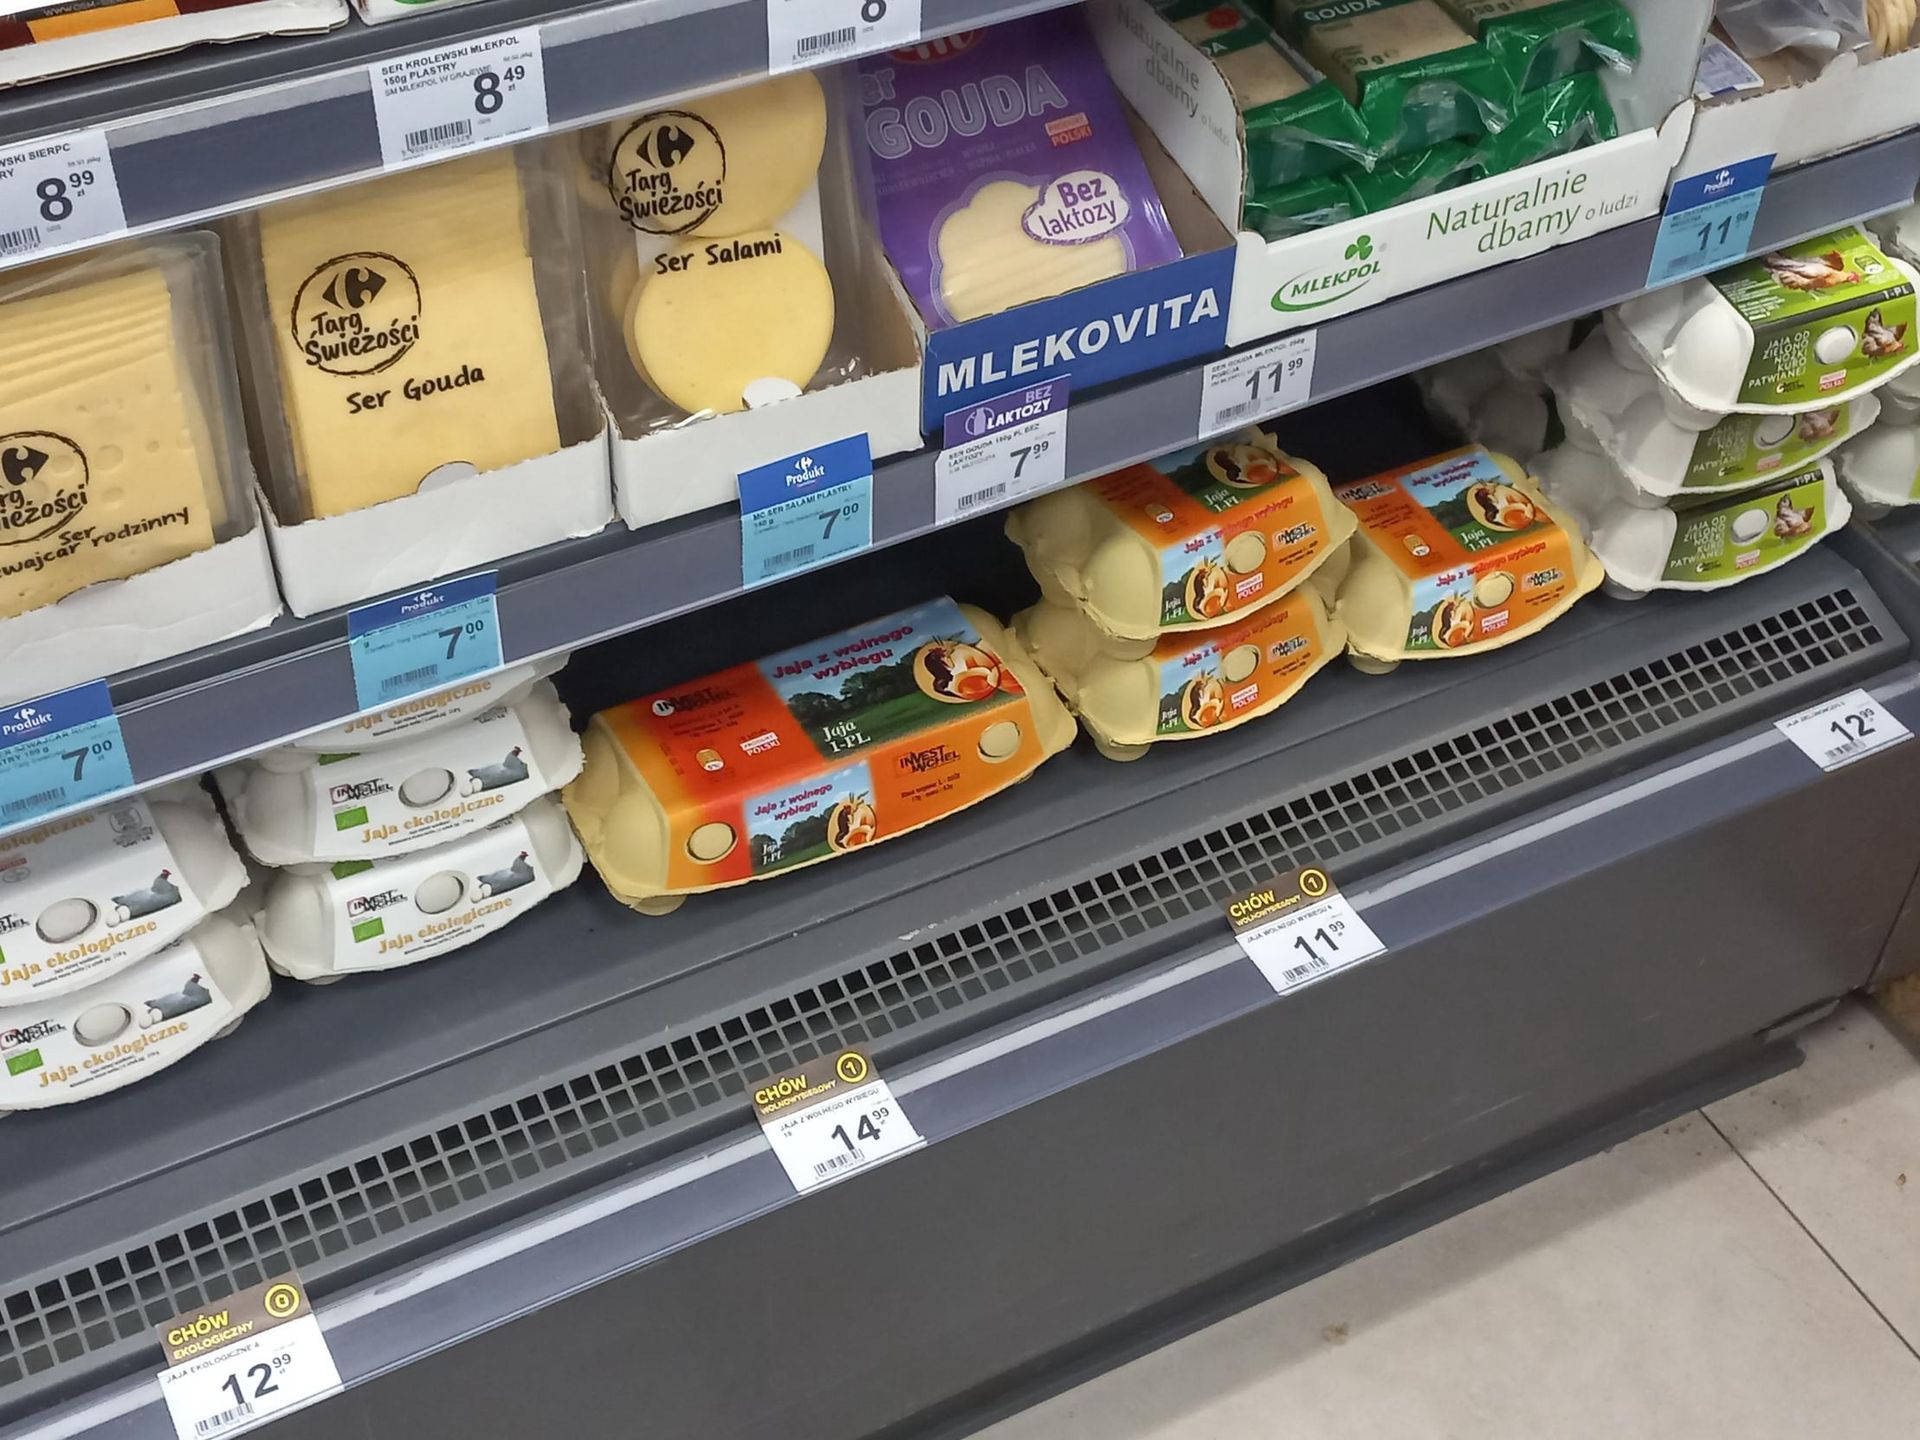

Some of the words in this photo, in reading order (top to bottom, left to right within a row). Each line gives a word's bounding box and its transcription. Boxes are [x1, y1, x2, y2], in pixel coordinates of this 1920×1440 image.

[382, 63, 403, 76] SER
[405, 49, 468, 70] KROLEWSKI
[470, 36, 519, 54] MLEKPOL
[384, 74, 407, 87] 150g
[409, 62, 457, 79] PLASTRY
[473, 72, 504, 115] 8
[503, 65, 525, 82] 49
[865, 64, 1068, 160] GOUDA
[28, 143, 71, 161] SIERPC
[1051, 125, 1093, 148] POLSKI
[36, 178, 73, 222] 8
[69, 170, 94, 188] 99
[619, 177, 723, 223] Świeżości
[626, 167, 674, 196] Targ
[1056, 177, 1107, 209] Bez
[1039, 200, 1117, 238] laktozy
[1426, 170, 1587, 240] Naturalnie
[1477, 202, 1581, 254] dbamy
[1585, 209, 1597, 222] o
[1599, 193, 1639, 217] ludzi
[1698, 215, 1732, 251] 11
[655, 250, 695, 276] Ser
[707, 233, 783, 266] Salami
[1291, 261, 1380, 298] MLEKPOL
[304, 317, 420, 368] Świeżości
[311, 311, 363, 340] Targ
[938, 288, 1220, 397] MLEKOVITA
[347, 388, 390, 415] Ser
[403, 365, 485, 403] Gouda
[1025, 385, 1053, 404] BEZ
[1246, 362, 1283, 401] 11
[1288, 357, 1303, 371] 99
[786, 464, 825, 487] Produkt
[1010, 446, 1032, 478] 7
[1033, 440, 1049, 455] 99
[58, 525, 95, 546] Ser
[91, 506, 191, 547] rodzinny
[819, 509, 841, 540] 7
[842, 502, 859, 517] 00
[1461, 528, 1485, 544] Jaja
[401, 594, 444, 614] Produkt
[439, 625, 463, 660] 7
[465, 620, 484, 635] 00
[773, 659, 813, 679] Jaja
[818, 653, 829, 664] z
[833, 624, 914, 657] wolnego
[812, 648, 894, 680] wybiegu
[2, 713, 53, 736] Produkt
[823, 719, 857, 743] Jaja
[830, 733, 872, 753] 1-PL
[1830, 714, 1876, 743] 12
[61, 746, 90, 782] 7
[92, 740, 112, 755] 00
[746, 739, 781, 757] POLSKI
[900, 745, 945, 769] INVEST
[774, 800, 818, 821] wybiegu
[789, 784, 833, 804] wolnego
[362, 824, 398, 843] Jaja
[403, 793, 504, 831] ekologiczne
[1307, 877, 1319, 889] 1
[1229, 890, 1276, 917] CHÓW
[378, 933, 414, 954] Jaja
[418, 896, 513, 939] ekologiczne
[1293, 927, 1340, 961] 11
[1328, 920, 1345, 933] 99
[1, 963, 42, 986] Jaja
[46, 921, 158, 969] ekologiczne
[39, 1063, 78, 1087] Jaja
[82, 1020, 189, 1070] ekologiczne
[845, 1061, 857, 1075] 1
[755, 1074, 808, 1105] CHÓW
[845, 1087, 880, 1105] WYBIEGU
[831, 1114, 881, 1151] 14
[872, 1107, 890, 1120] 99
[168, 1310, 230, 1347] CHÓW
[173, 1321, 254, 1360] EKOLOGICZNY
[166, 1369, 188, 1384] JAJA
[190, 1344, 253, 1374] EKOLOGICZNE
[222, 1362, 279, 1405] 12
[272, 1353, 292, 1369] 99
